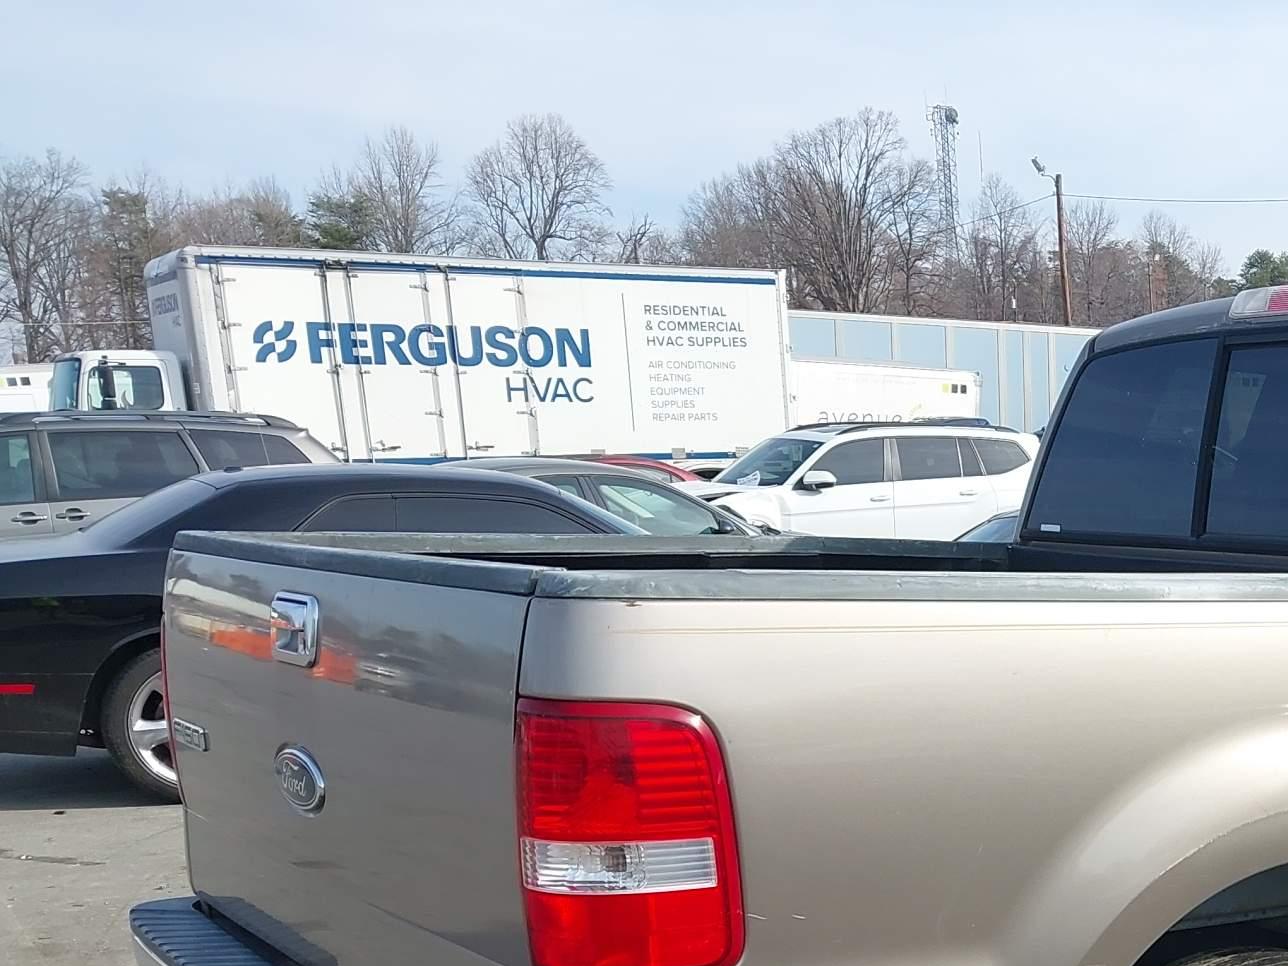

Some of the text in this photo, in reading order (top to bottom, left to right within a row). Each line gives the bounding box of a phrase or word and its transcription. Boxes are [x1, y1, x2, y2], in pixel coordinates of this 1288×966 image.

[643, 304, 727, 317] RESIDENTIAL
[645, 320, 745, 333] & COMMERCIAL
[305, 321, 592, 368] FERGUSON
[646, 335, 748, 348] HVAC SUPPLIES
[648, 360, 737, 370] AIR CONDITIONING
[649, 373, 692, 382] HEATING
[505, 376, 595, 403] HVAC
[650, 386, 705, 396] EQUIPMENT
[651, 399, 696, 409] SUPPLIES
[652, 412, 719, 422] REPAIR PARTS
[281, 760, 306, 797] Ford
